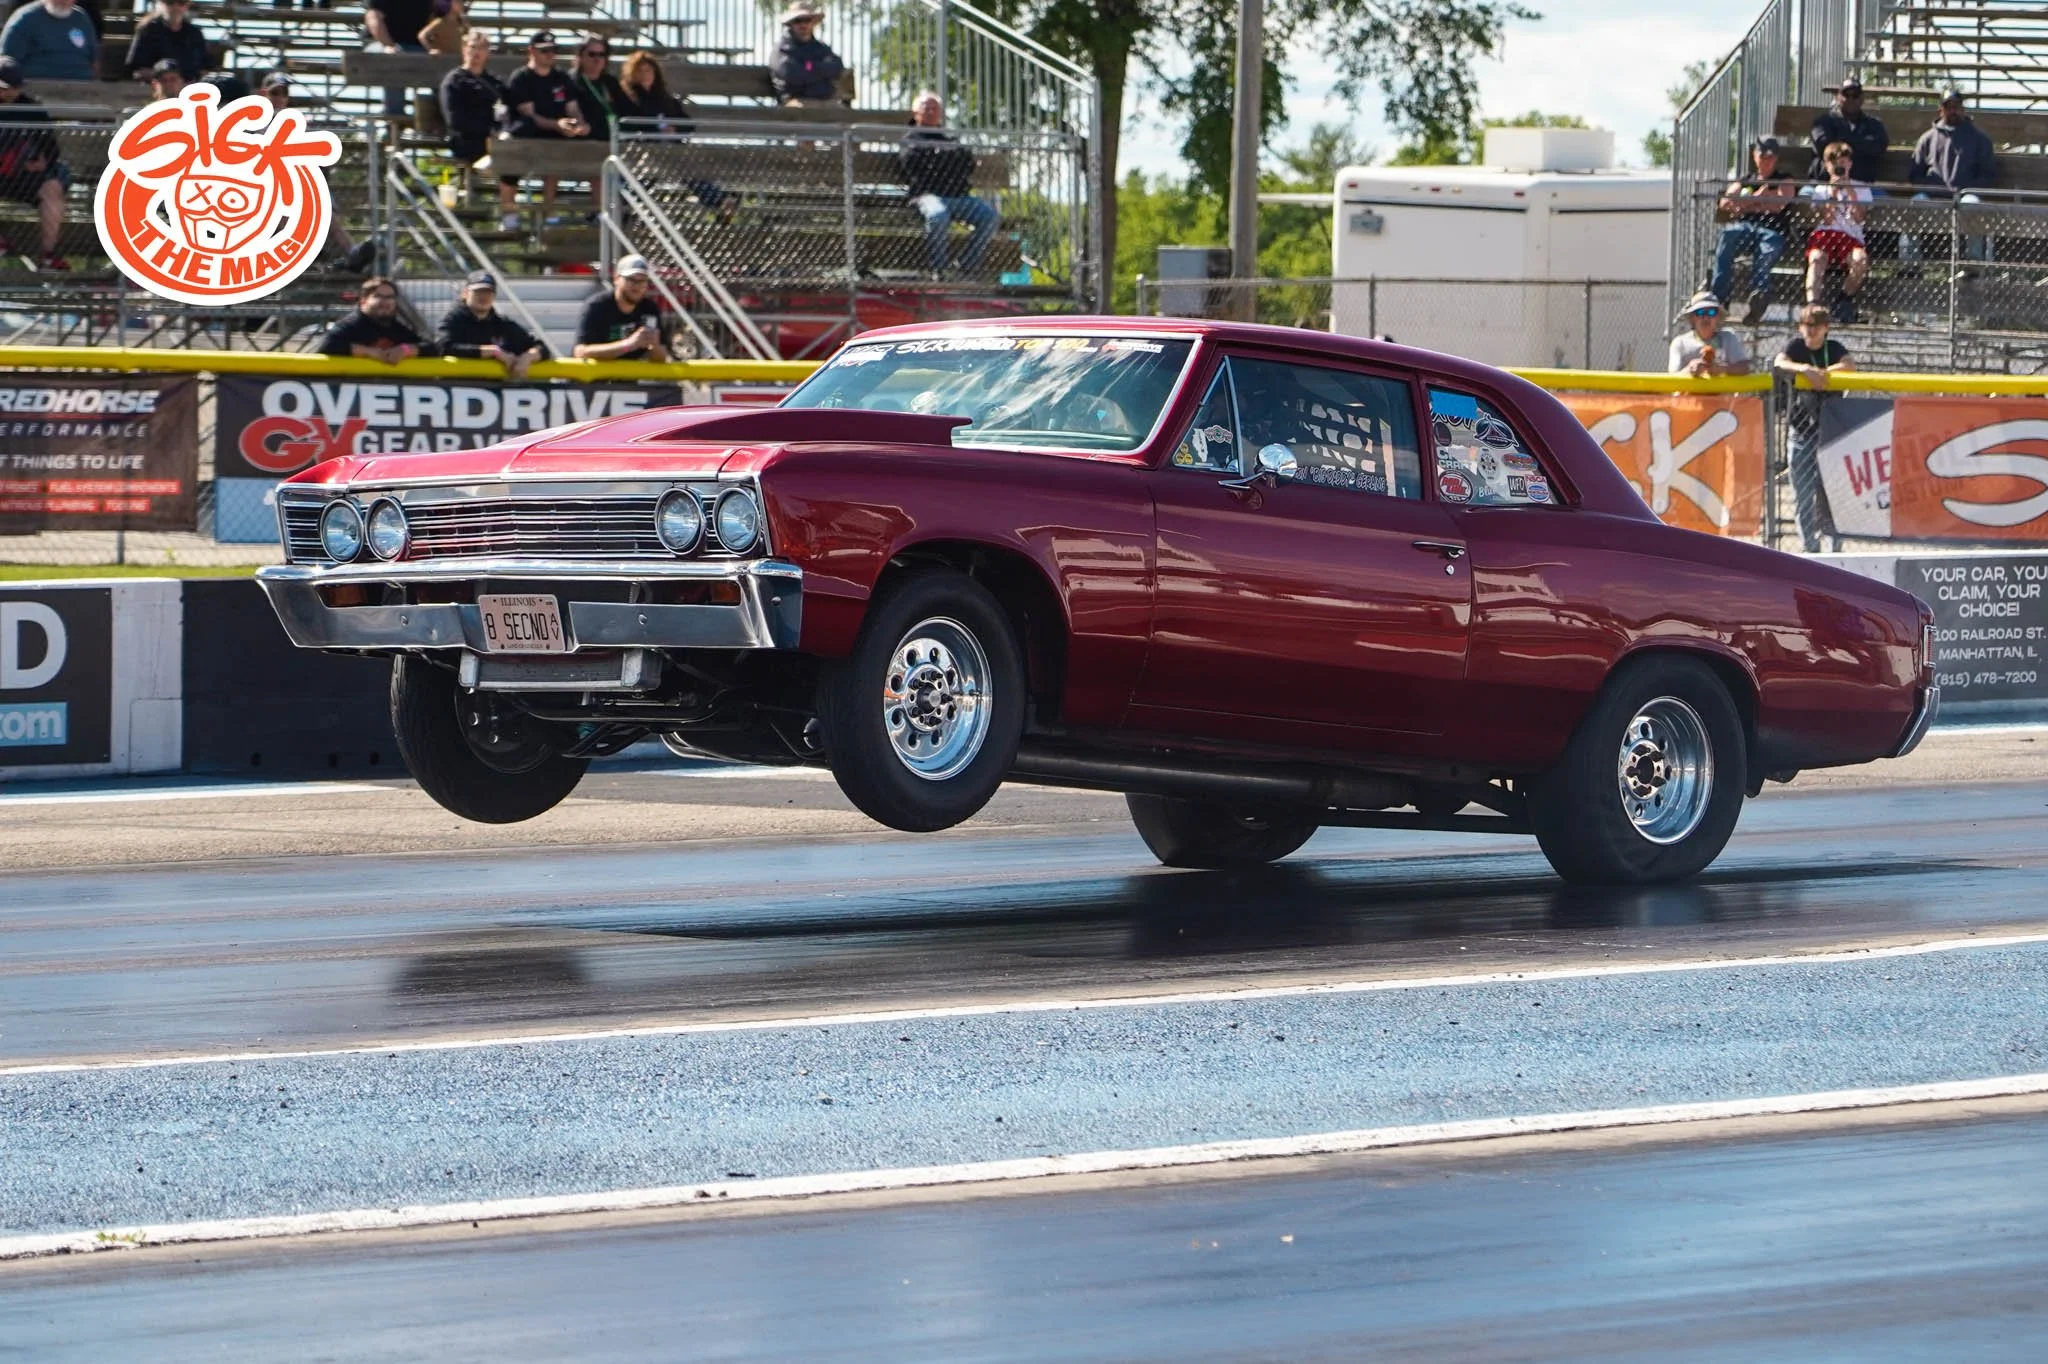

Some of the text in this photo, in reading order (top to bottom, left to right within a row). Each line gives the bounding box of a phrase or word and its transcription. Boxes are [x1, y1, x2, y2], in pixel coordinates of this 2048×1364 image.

[0, 389, 159, 413] REDHORSE
[262, 381, 648, 430] OVERDRIVE
[353, 431, 458, 454] GEAR
[12, 454, 77, 470] THINGS
[80, 455, 106, 470] TO
[108, 455, 144, 470] LIFE
[1926, 419, 2048, 527] S
[1921, 565, 2048, 583] YOUR CAR, YOU
[1938, 584, 2041, 601] CLAIM, YOUR
[501, 597, 536, 607] ILLINOIS
[1959, 602, 2020, 617] CHOICE!
[503, 613, 549, 640] SECND
[1960, 628, 2023, 641] RAILROAD
[2026, 627, 2047, 639] ST.
[0, 601, 67, 690] D
[1938, 646, 2038, 661] MANHATTAN, IL
[1973, 670, 2037, 685] 478-7200
[0, 710, 62, 740] om
